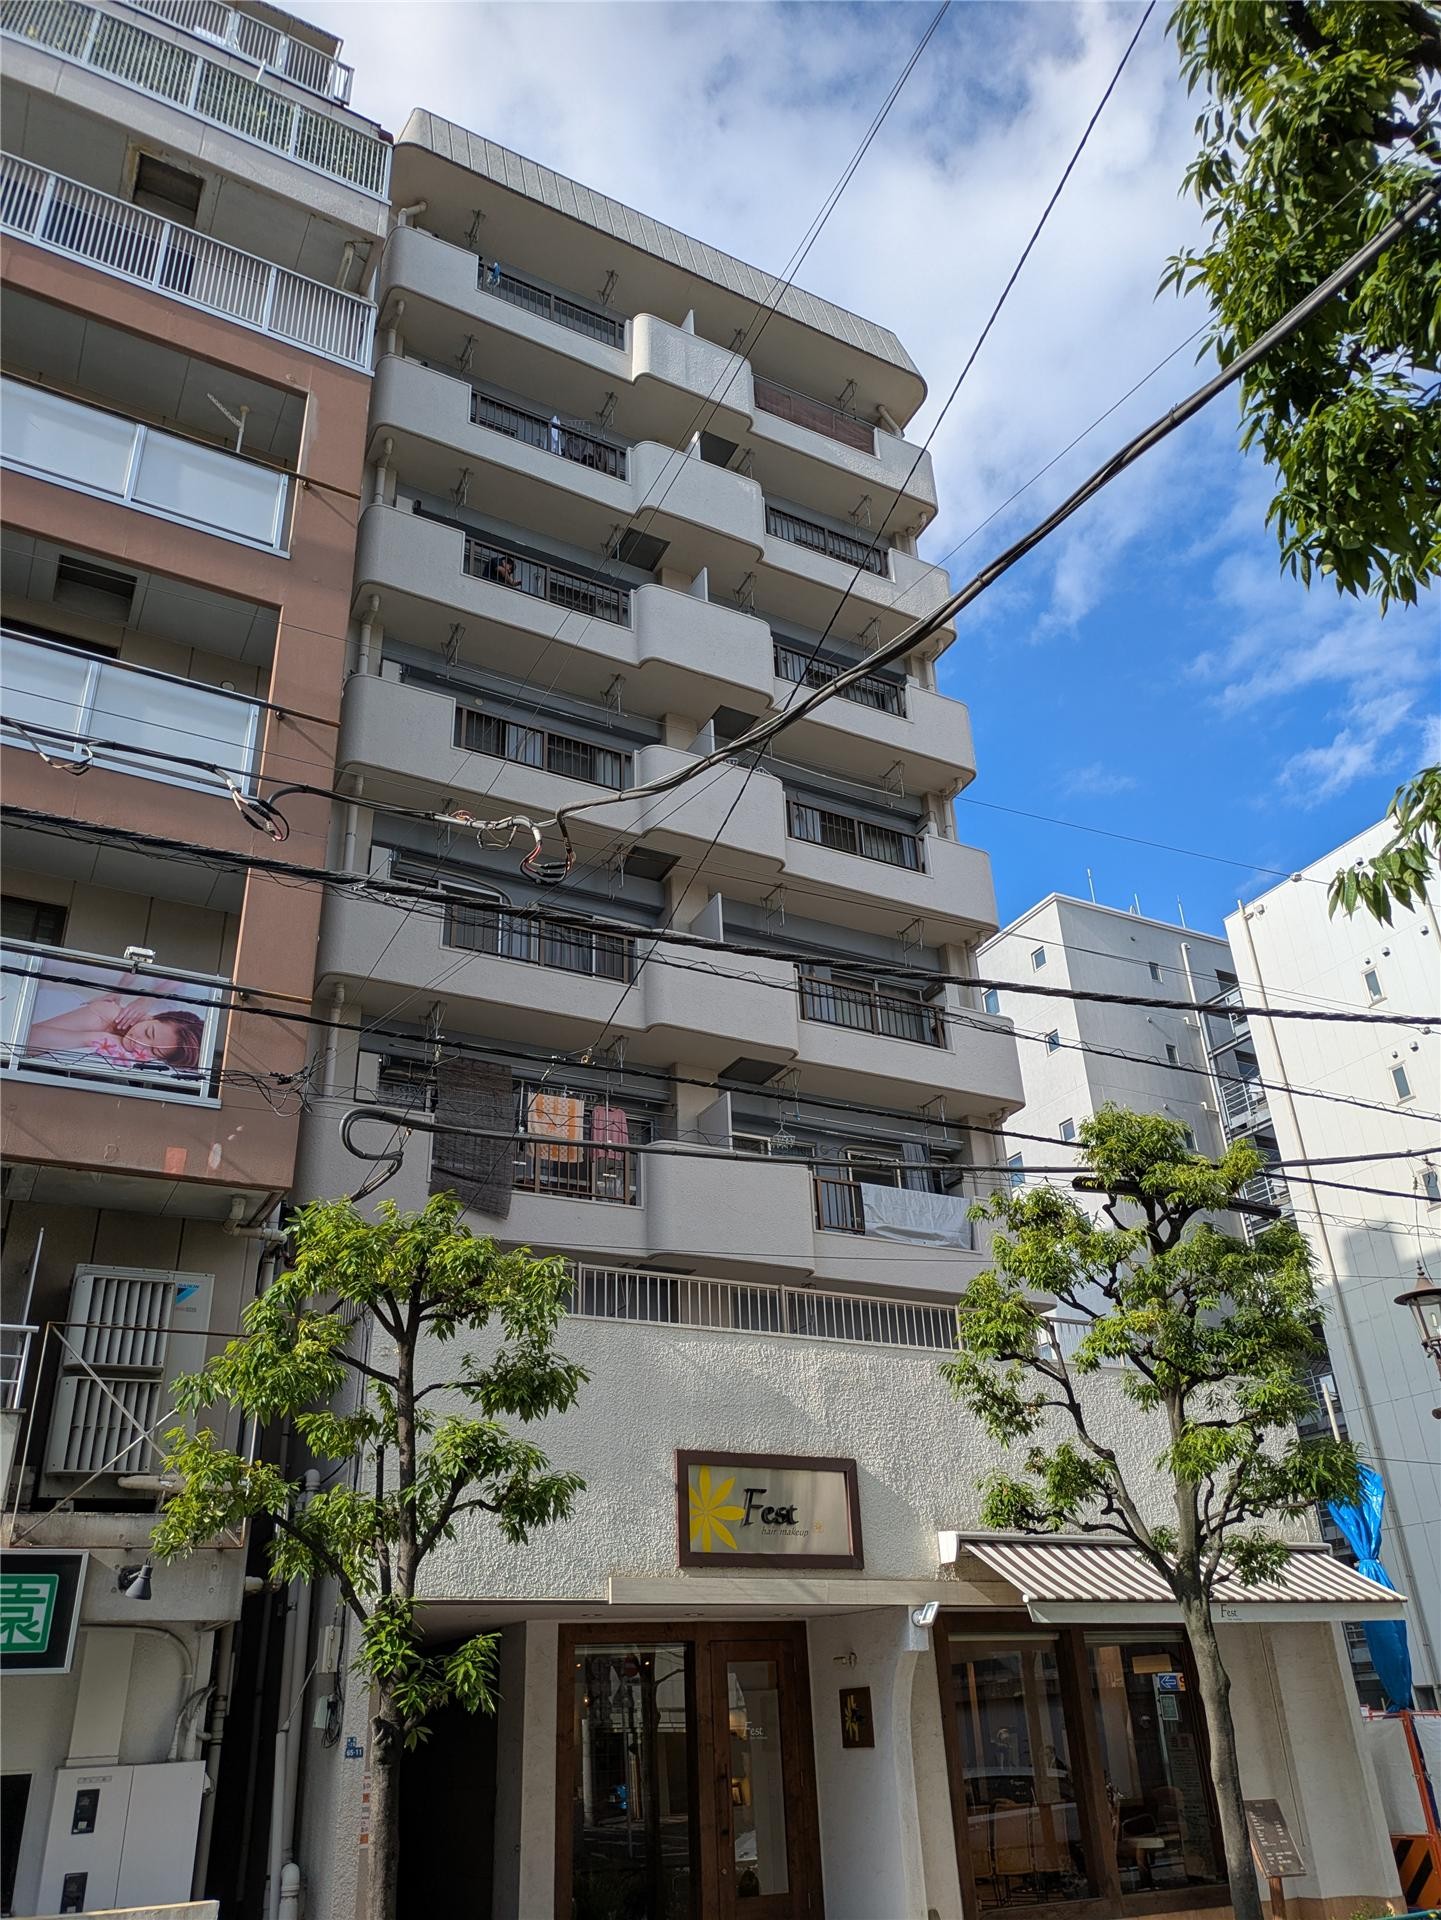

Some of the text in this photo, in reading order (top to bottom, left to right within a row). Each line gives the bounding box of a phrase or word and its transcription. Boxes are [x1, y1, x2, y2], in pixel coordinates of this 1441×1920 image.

[743, 1488, 799, 1526] Fest
[761, 1526, 809, 1537] hair makeup
[1221, 1604, 1237, 1617] Fest
